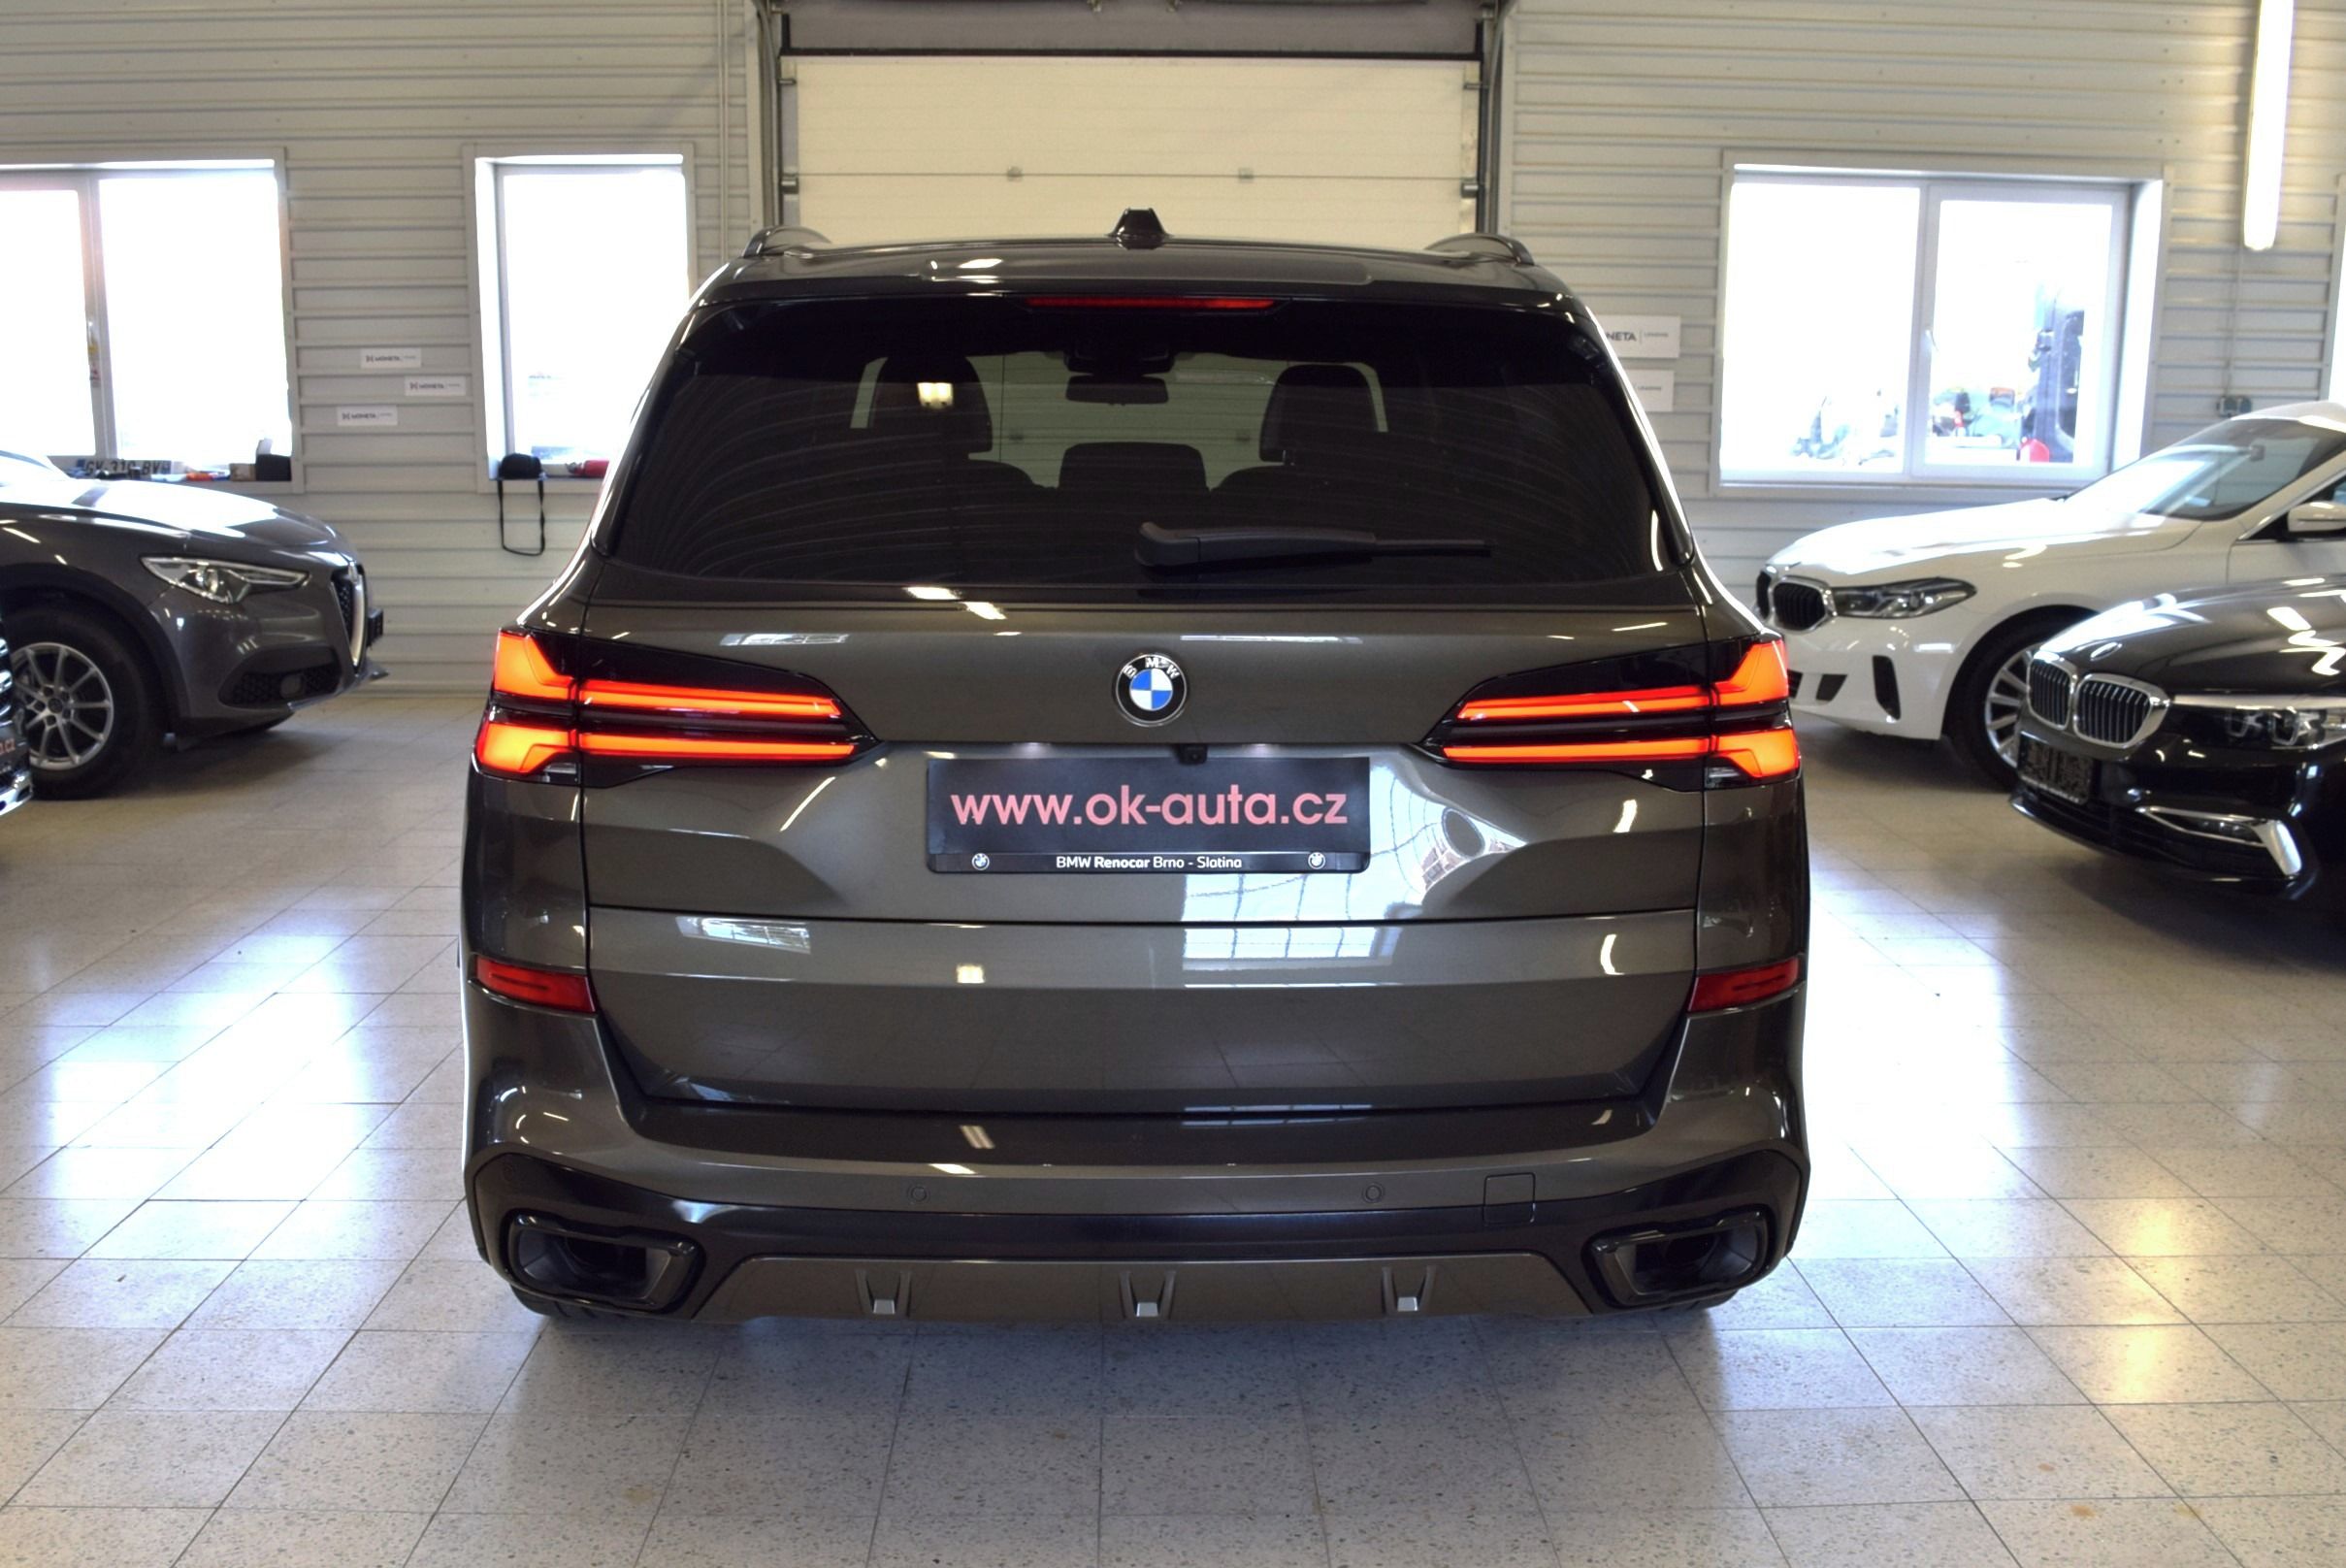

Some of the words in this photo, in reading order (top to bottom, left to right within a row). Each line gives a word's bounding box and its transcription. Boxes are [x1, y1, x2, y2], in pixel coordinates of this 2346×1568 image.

[1606, 331, 1637, 342] NETA
[1124, 657, 1181, 679] BMW
[950, 784, 1349, 826] www.ok-auta.cz
[1056, 856, 1092, 868] BMW
[1093, 856, 1150, 868] Renocar
[1153, 856, 1185, 868] Brno
[1196, 856, 1243, 868] Slatina
